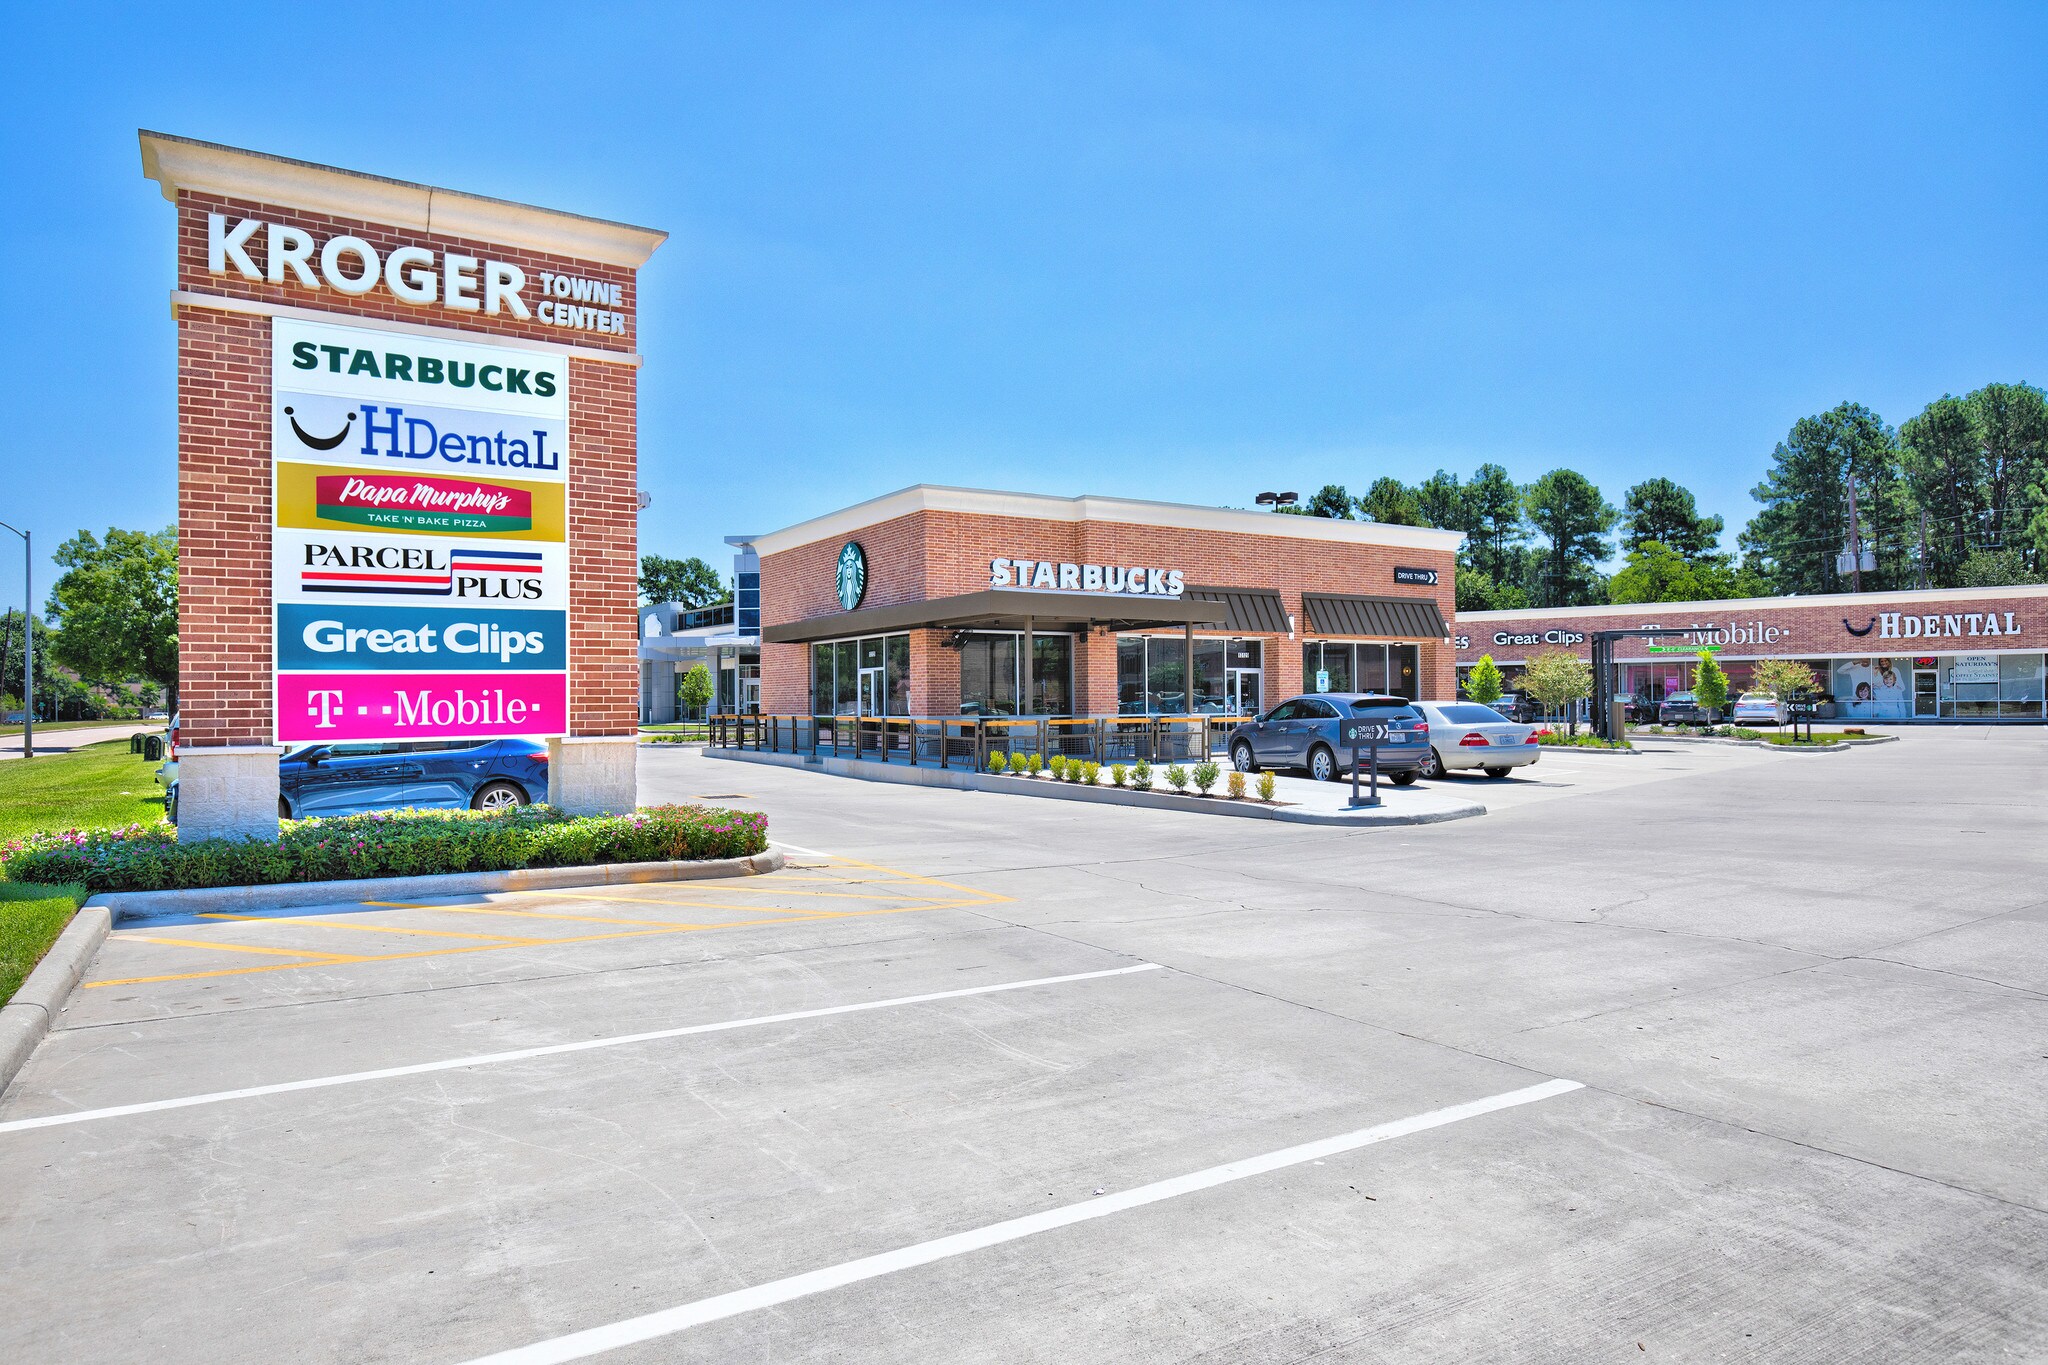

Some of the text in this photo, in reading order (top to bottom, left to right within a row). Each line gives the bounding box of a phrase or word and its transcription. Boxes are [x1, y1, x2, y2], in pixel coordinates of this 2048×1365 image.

[208, 213, 532, 321] KROGER
[540, 272, 623, 308] TOWNE
[537, 300, 626, 336] CENTER
[292, 341, 557, 398] STARBUCKS
[339, 477, 512, 514] Papa Murphy's
[367, 513, 400, 523] TAKE
[417, 517, 450, 526] BAKE
[453, 519, 487, 528] PIZZA
[304, 544, 447, 571] PARCEL
[456, 577, 543, 600] PLUS
[990, 558, 1185, 596] STARBUCKS
[1397, 572, 1428, 581] DRIVE THRU
[1493, 630, 1584, 647] Great Clips
[1879, 612, 2021, 639] HDENTAL
[302, 620, 544, 663] Great Clips
[1357, 725, 1375, 733] DRIVE
[1358, 732, 1374, 740] THRU
